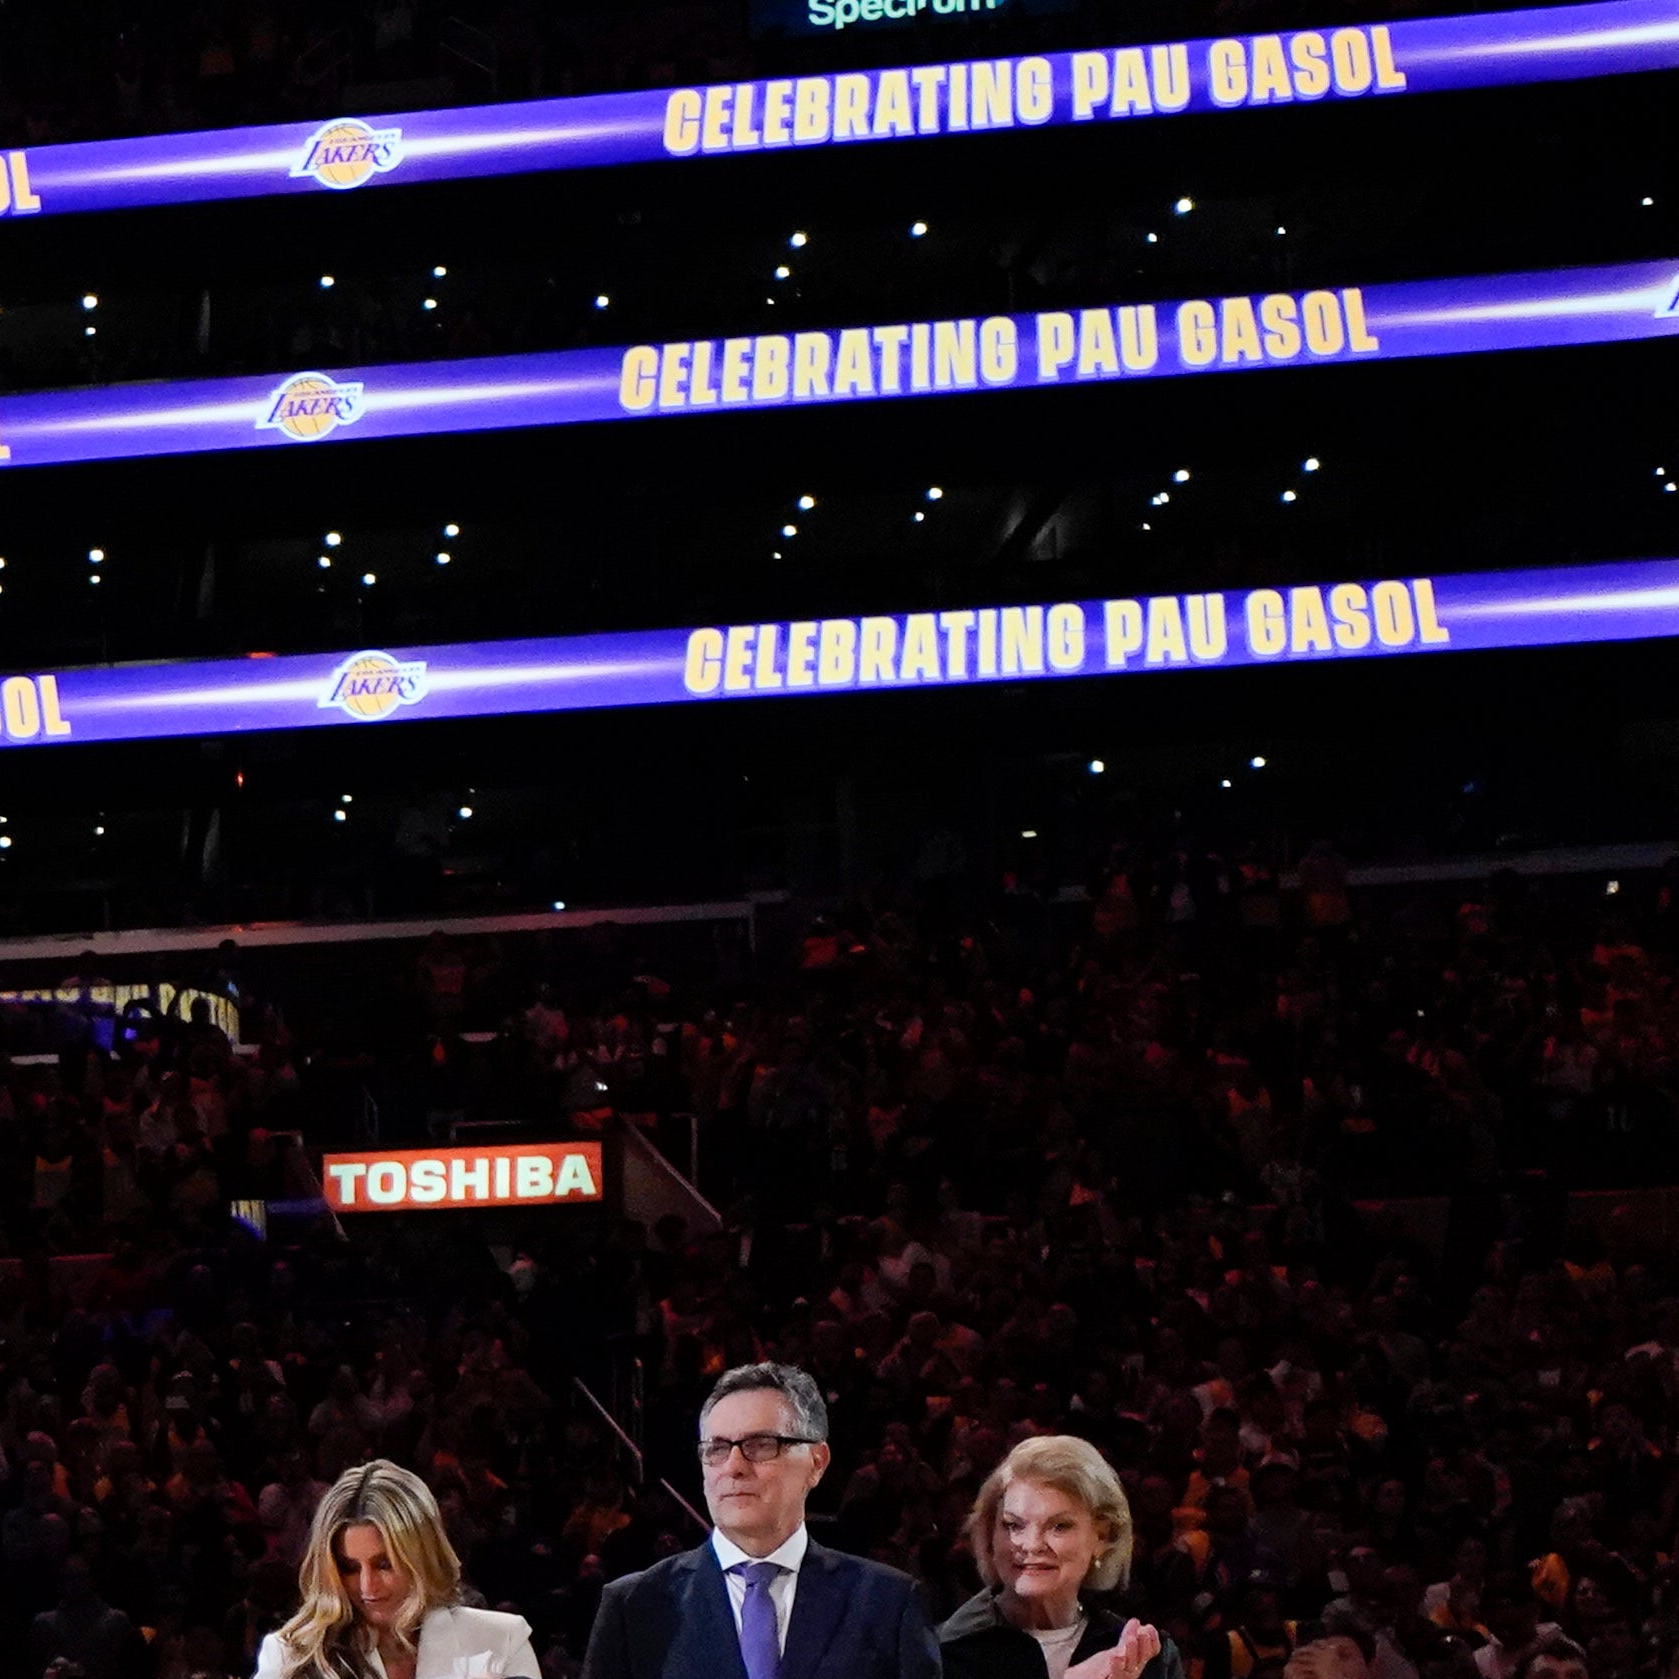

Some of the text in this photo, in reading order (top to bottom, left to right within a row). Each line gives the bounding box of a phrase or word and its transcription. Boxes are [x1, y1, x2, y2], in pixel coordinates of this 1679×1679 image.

[662, 25, 1407, 153] CELEBRATING PAU GASOL
[302, 140, 392, 171] LAKERS
[618, 288, 1380, 411] CELEBRATING PAU GASOL
[267, 393, 354, 423] LAKERS
[682, 579, 1451, 695] CELEBRATING PAU GASOL
[330, 672, 417, 701] LAKERS
[329, 1154, 598, 1205] TOSHIBA
